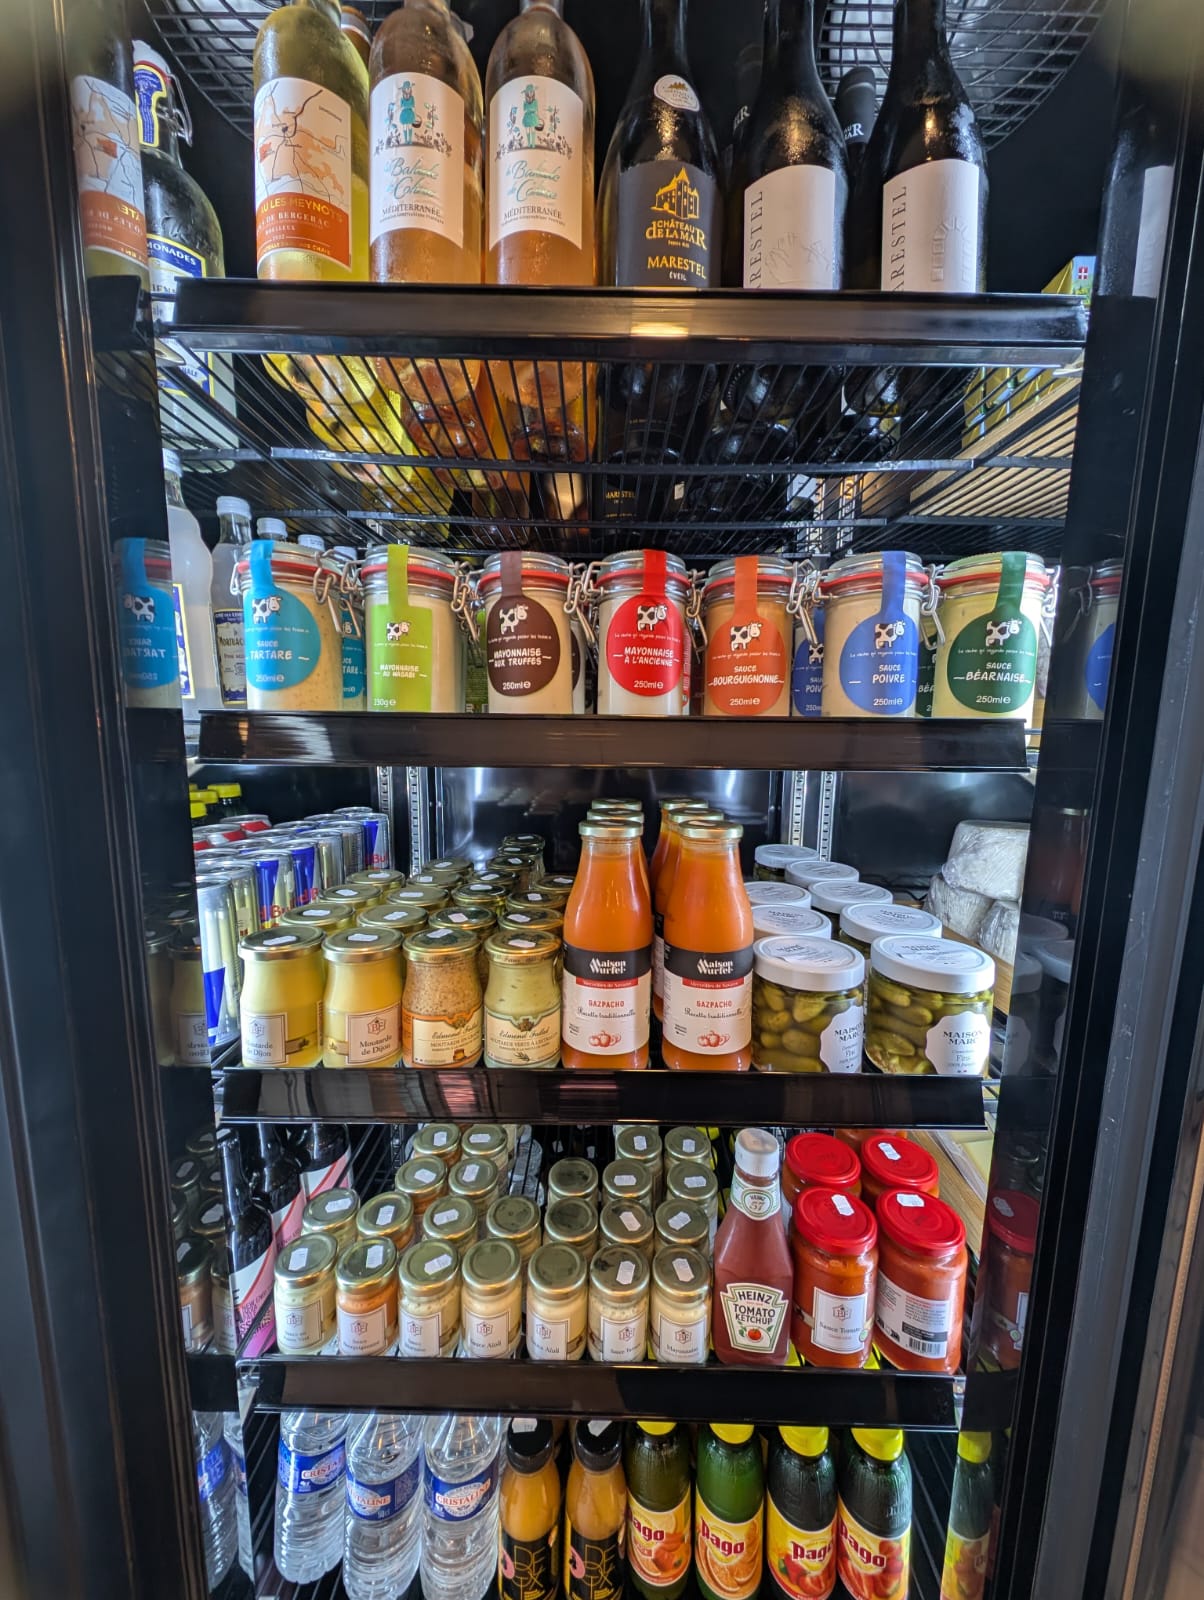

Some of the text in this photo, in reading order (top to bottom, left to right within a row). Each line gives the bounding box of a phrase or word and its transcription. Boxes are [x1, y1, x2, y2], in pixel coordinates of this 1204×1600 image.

[656, 218, 695, 233] CHÂTEAU
[750, 191, 763, 289] RESTEL
[647, 255, 707, 280] MARESTEL
[256, 640, 279, 648] SAUCE
[250, 649, 293, 661] TARTARE
[493, 647, 542, 659] MAYONNAISE
[624, 646, 674, 658] MAYONNAISE
[508, 657, 542, 667] TRUFFES
[632, 655, 673, 667] L'ANCIENNE
[985, 661, 1012, 670] SAUCE
[380, 663, 420, 672] MAYONNAISE
[734, 665, 757, 673] SAUCE
[879, 664, 902, 672] SAUCE
[713, 674, 779, 686] BOURGUIGNONNE
[872, 674, 905, 684] POIVRE
[965, 668, 1026, 682] BÉARNAISE
[588, 999, 625, 1008] GAZPACHO
[696, 999, 733, 1008] GAZPACHO
[750, 1201, 766, 1211] 57
[737, 1290, 773, 1305] HEINZ
[732, 1304, 776, 1318] TOMATO
[735, 1313, 773, 1326] KETCHUP
[437, 1478, 490, 1506] CRISTALINE
